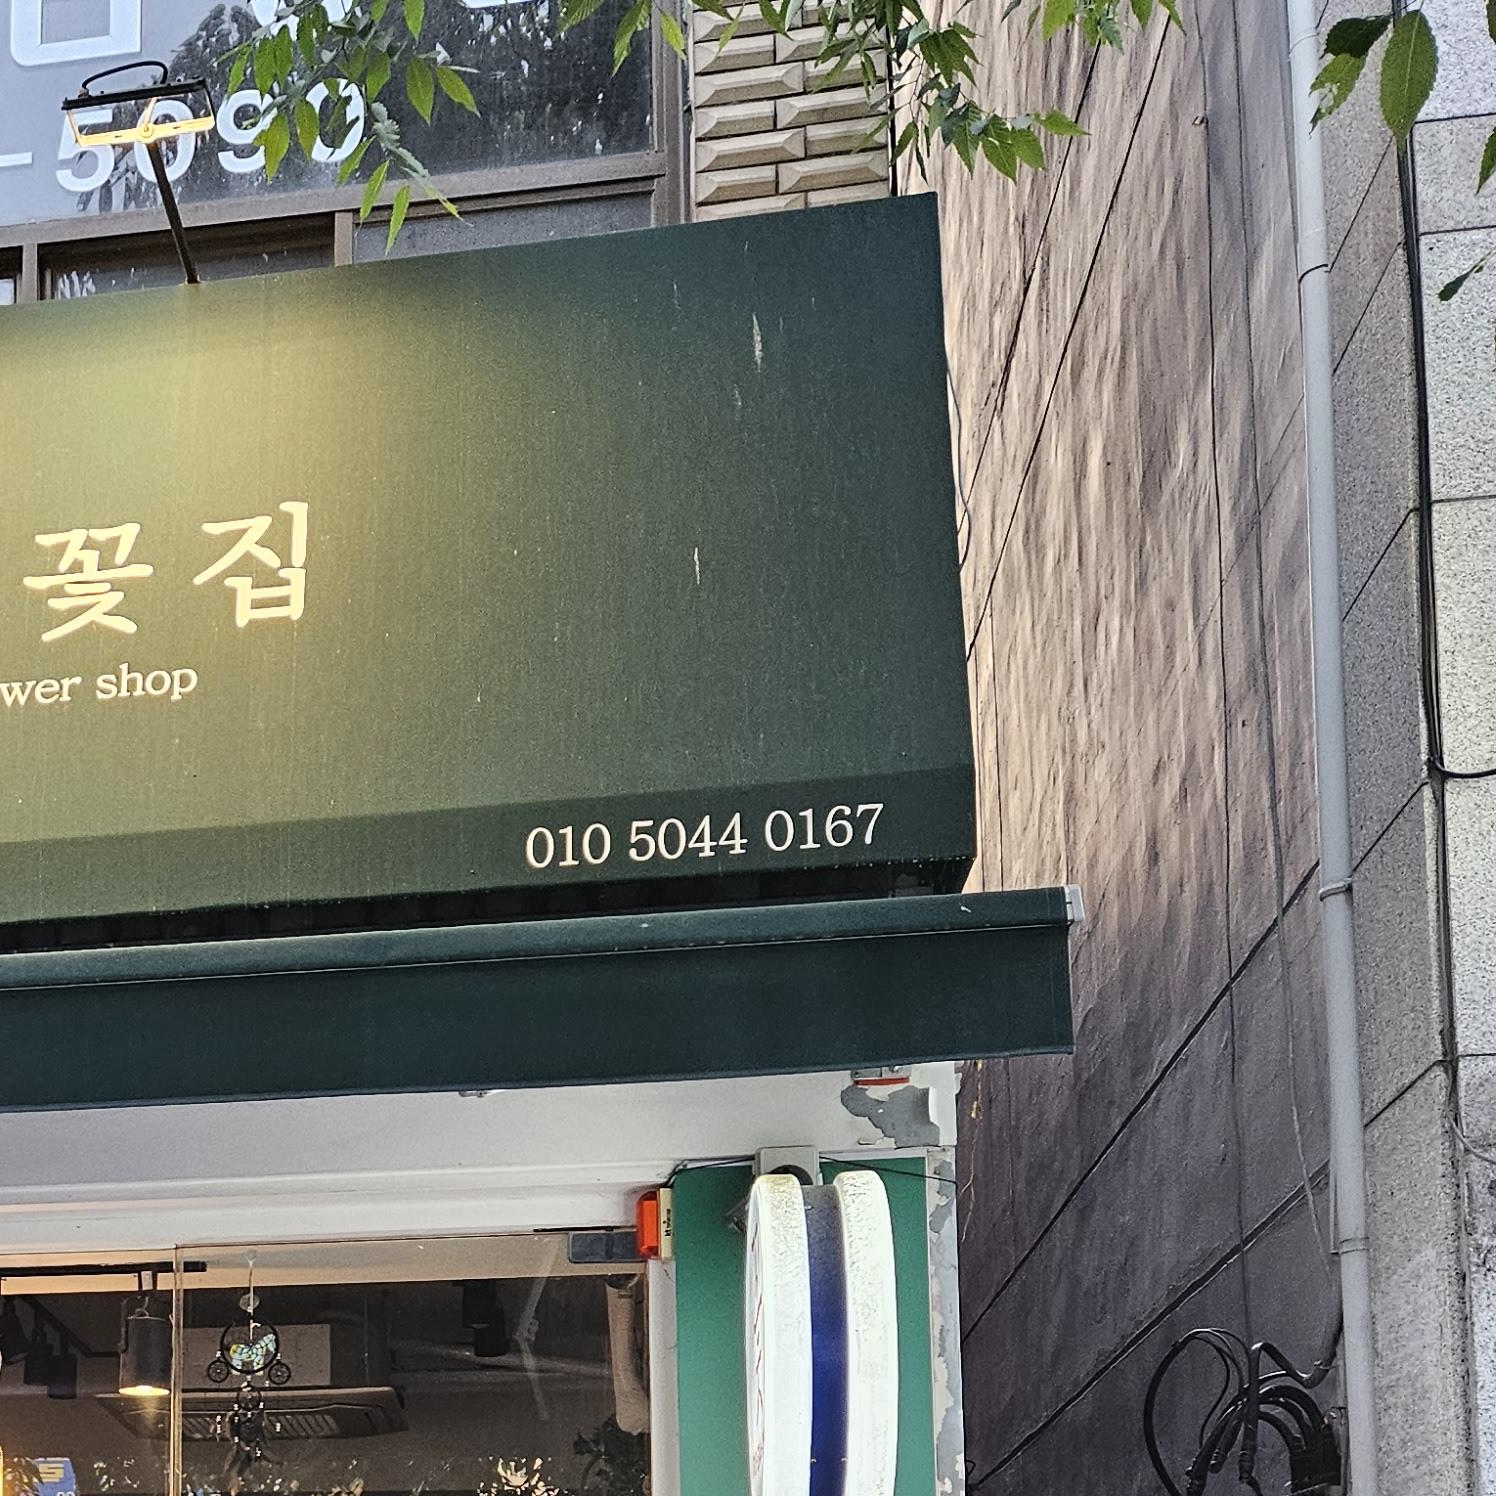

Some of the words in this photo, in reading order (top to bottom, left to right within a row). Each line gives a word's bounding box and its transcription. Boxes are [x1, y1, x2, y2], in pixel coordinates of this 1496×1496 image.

[94, 662, 199, 703] shop
[525, 821, 612, 869] 010
[627, 812, 749, 862] 5044
[764, 802, 885, 852] 0167
